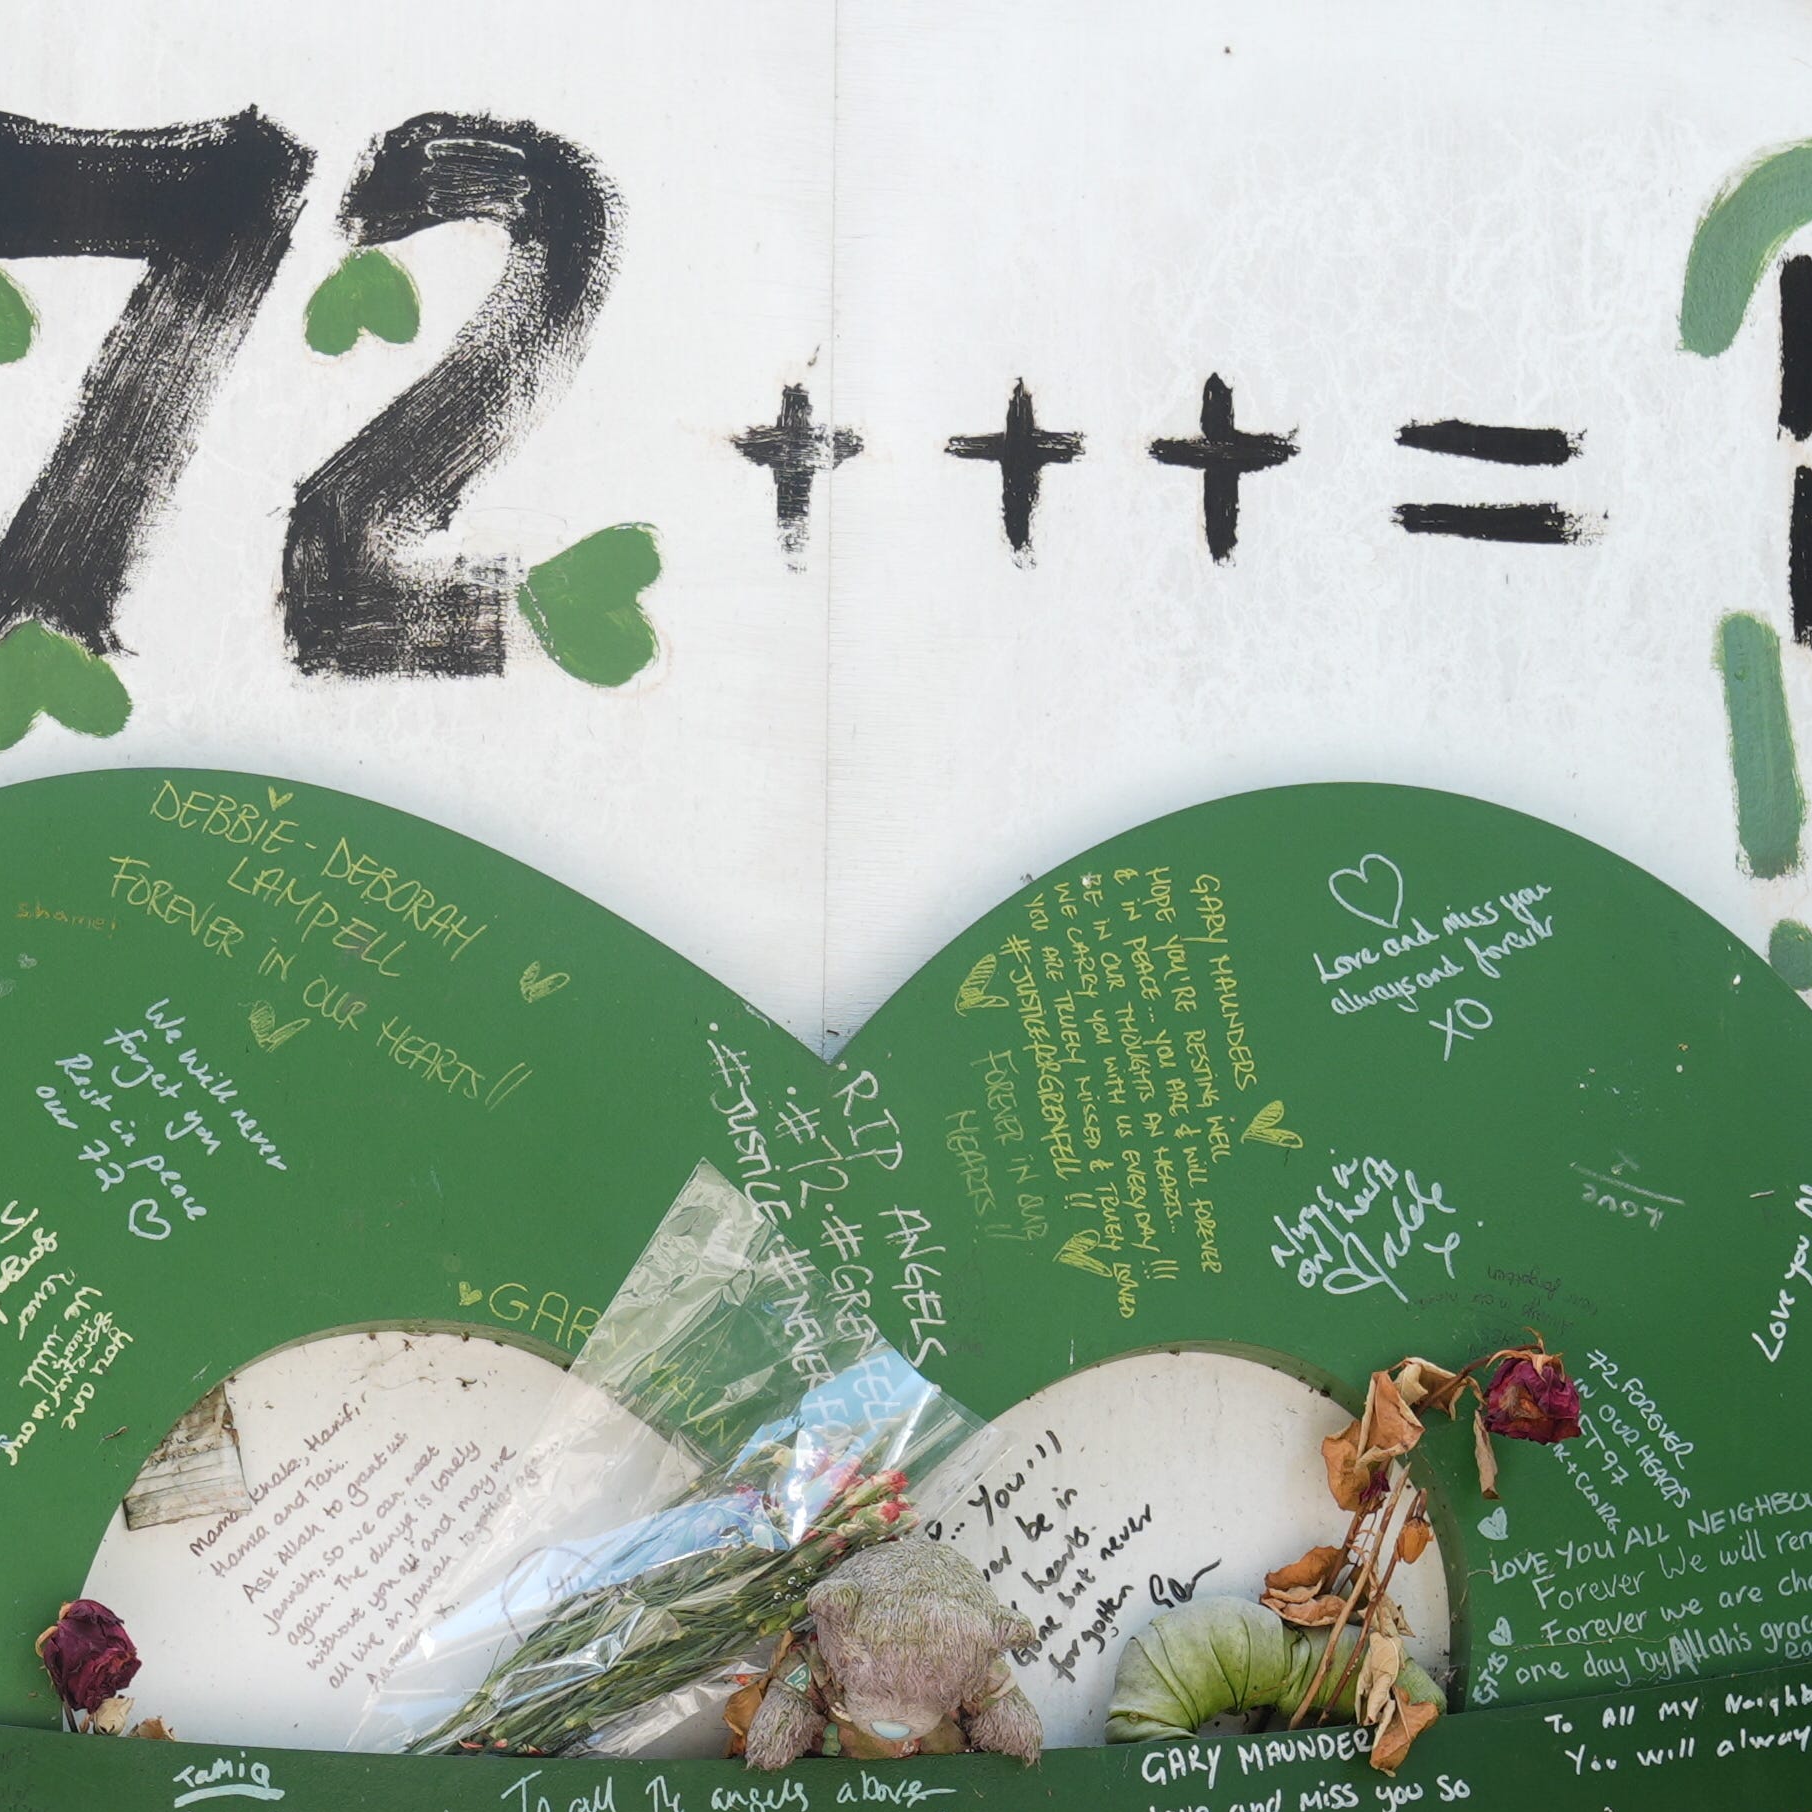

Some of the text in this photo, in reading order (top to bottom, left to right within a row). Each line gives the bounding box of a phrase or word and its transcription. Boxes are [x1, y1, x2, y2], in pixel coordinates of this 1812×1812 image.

[149, 780, 487, 961] DEBBIE DEBORAH
[229, 858, 400, 976] LAMPELL
[1314, 882, 1552, 983] Love and miss you
[109, 854, 244, 958] FOREVER
[302, 974, 367, 1031] OUR
[1191, 874, 1257, 1092] GARY MAUNDERS
[1330, 915, 1554, 1016] always and forever
[55, 1054, 207, 1221] Rest in peace
[105, 1026, 219, 1156] forget you
[144, 998, 287, 1171] We will never
[834, 1069, 949, 1368] RIP ANGELS
[1752, 1288, 1796, 1362] Love
[1490, 1550, 1549, 1586] LOVE
[1554, 1538, 1615, 1575] YOU
[1624, 1523, 1670, 1551] ALL
[1532, 1570, 1646, 1612] Forever
[1661, 1549, 1708, 1580] We
[1718, 1534, 1767, 1569] will
[1140, 1727, 1379, 1789] GARY MAUNDER
